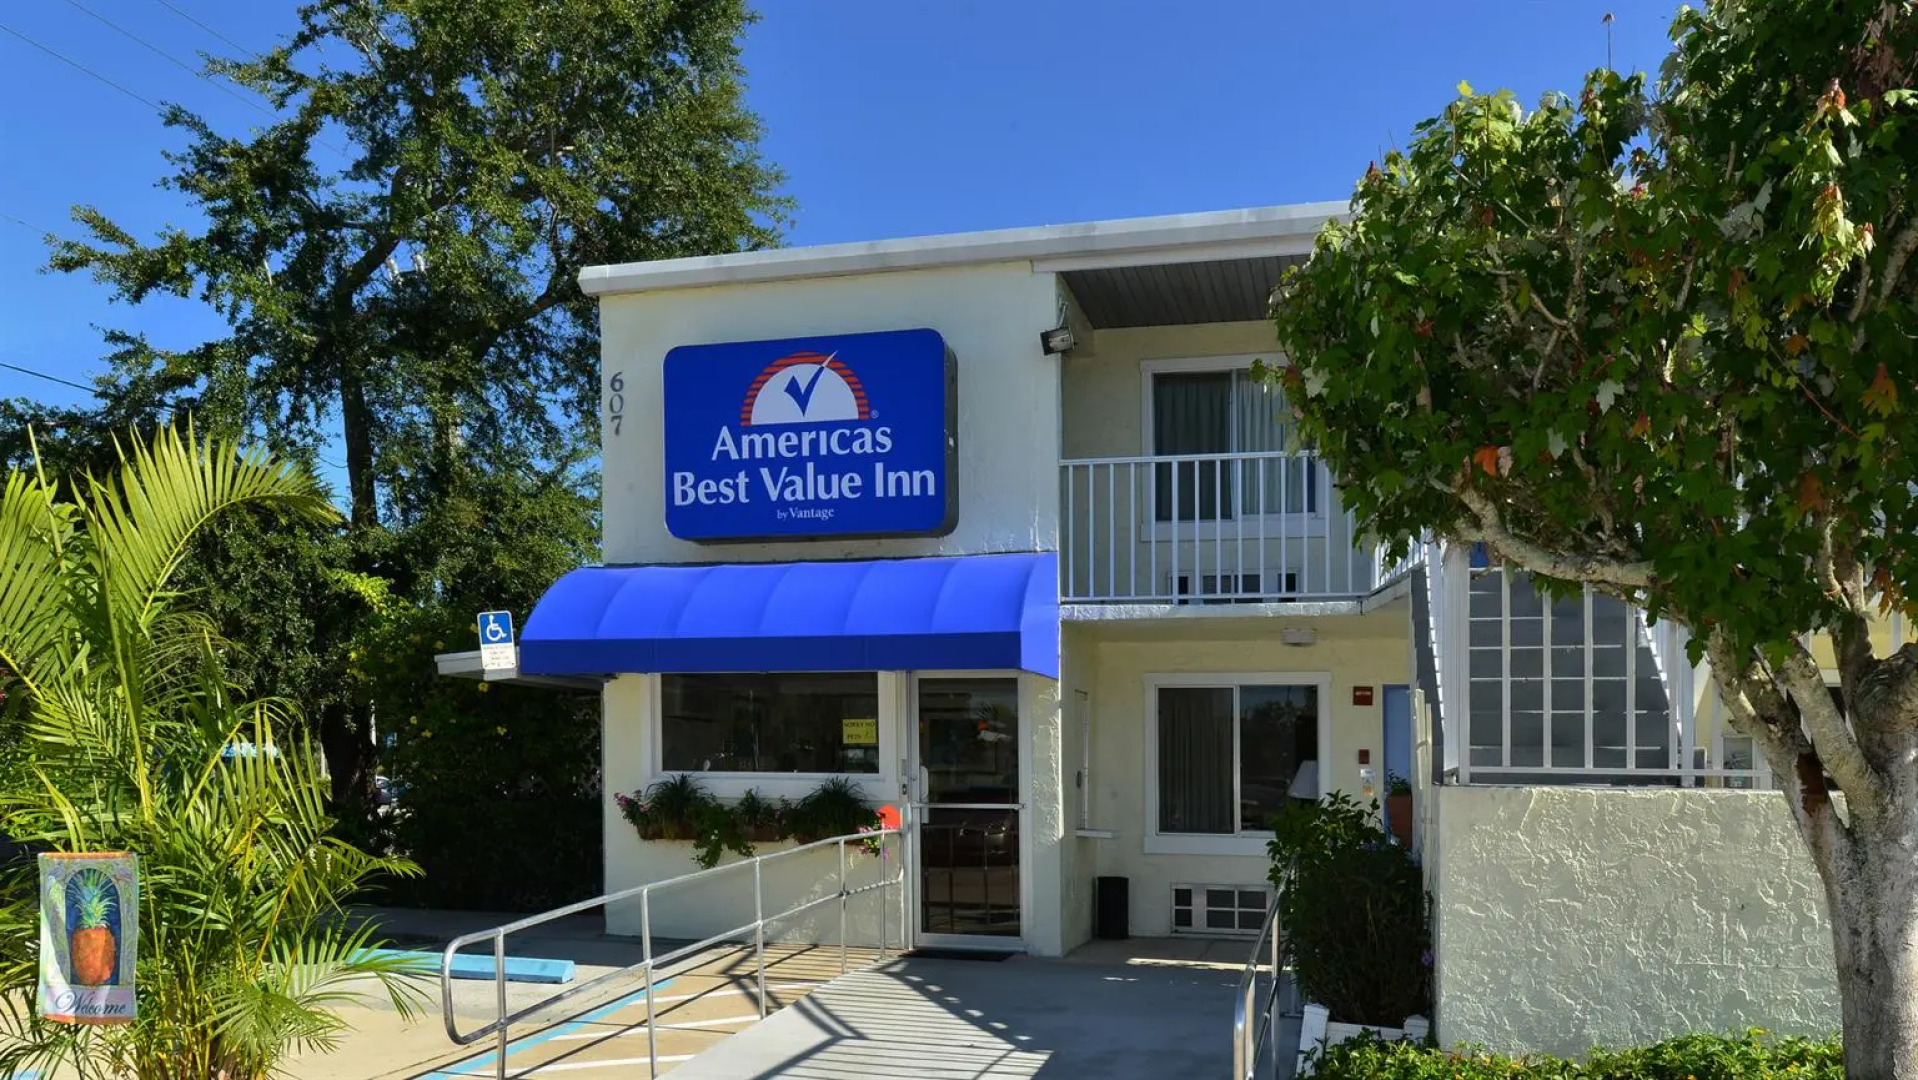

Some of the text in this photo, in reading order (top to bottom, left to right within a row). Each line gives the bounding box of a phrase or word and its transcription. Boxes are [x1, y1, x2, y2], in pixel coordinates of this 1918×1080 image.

[609, 371, 624, 436] 607
[711, 425, 893, 461] Americas
[673, 461, 936, 506] Best Value Inn
[777, 507, 834, 521] by Vantage
[55, 989, 127, 1015] Welcome
